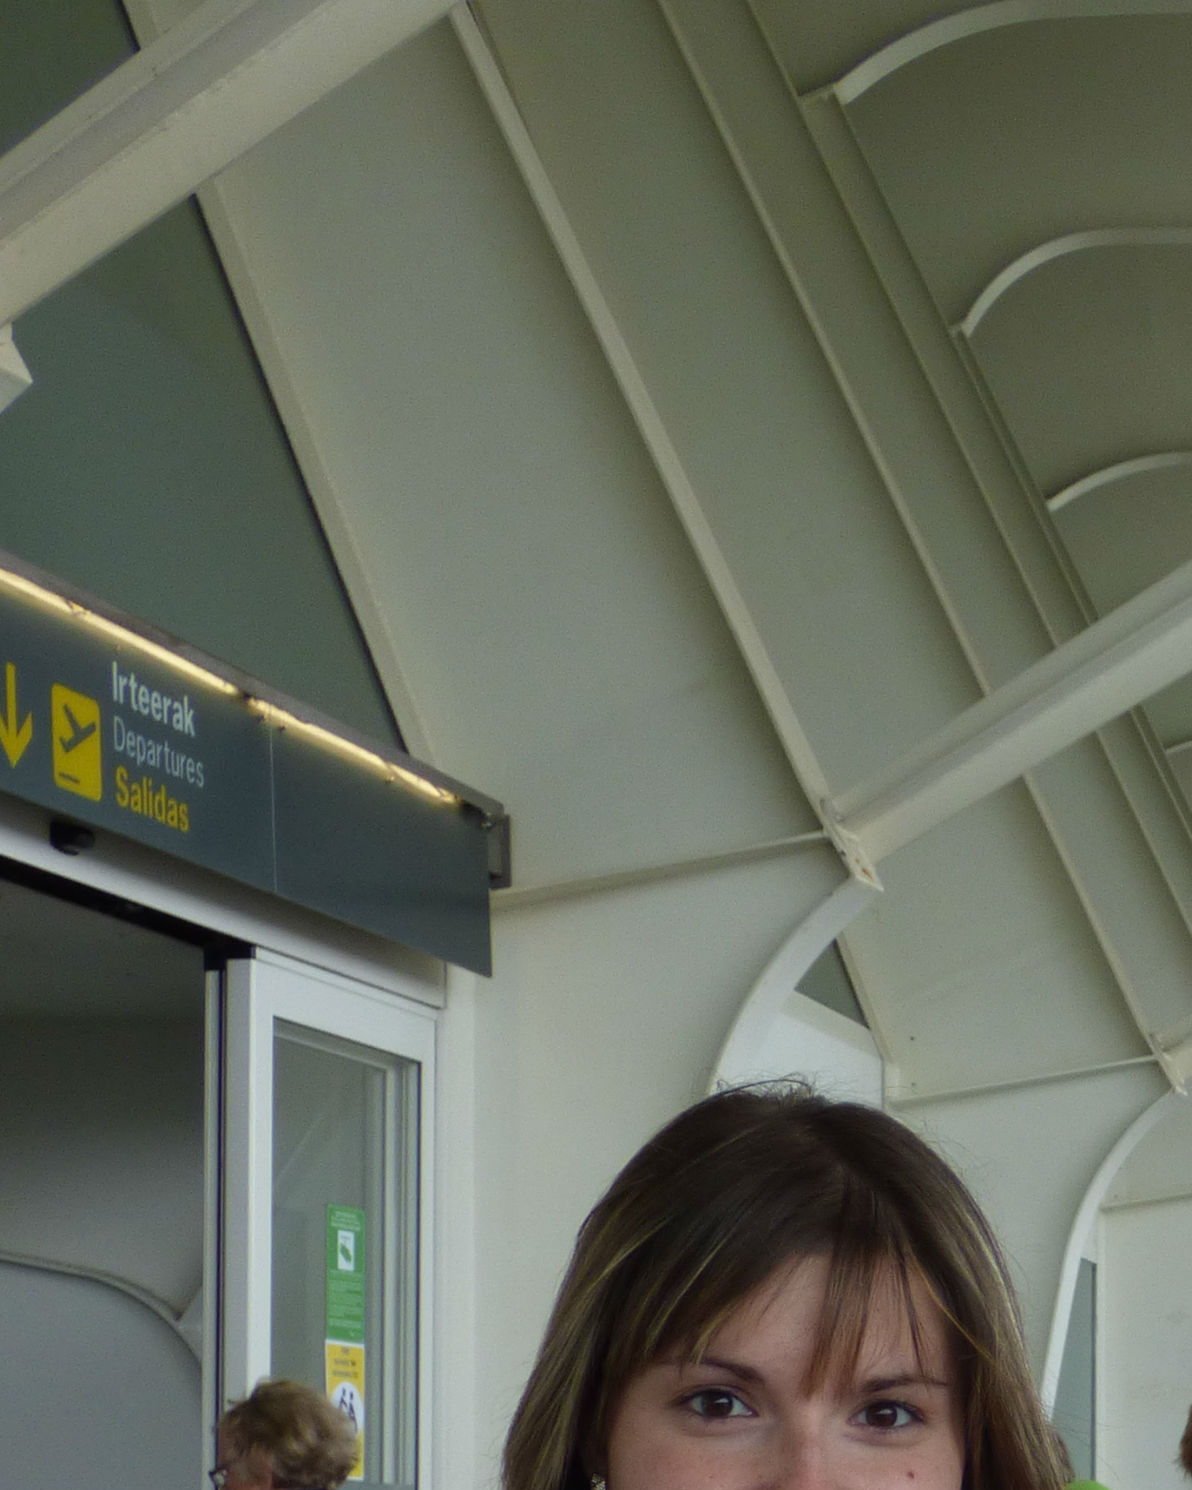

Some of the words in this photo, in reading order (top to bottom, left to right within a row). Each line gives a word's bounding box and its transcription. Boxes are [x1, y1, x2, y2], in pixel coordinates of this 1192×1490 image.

[112, 661, 195, 736] Irteerak
[113, 715, 204, 788] Departures
[115, 766, 189, 832] Salidas
